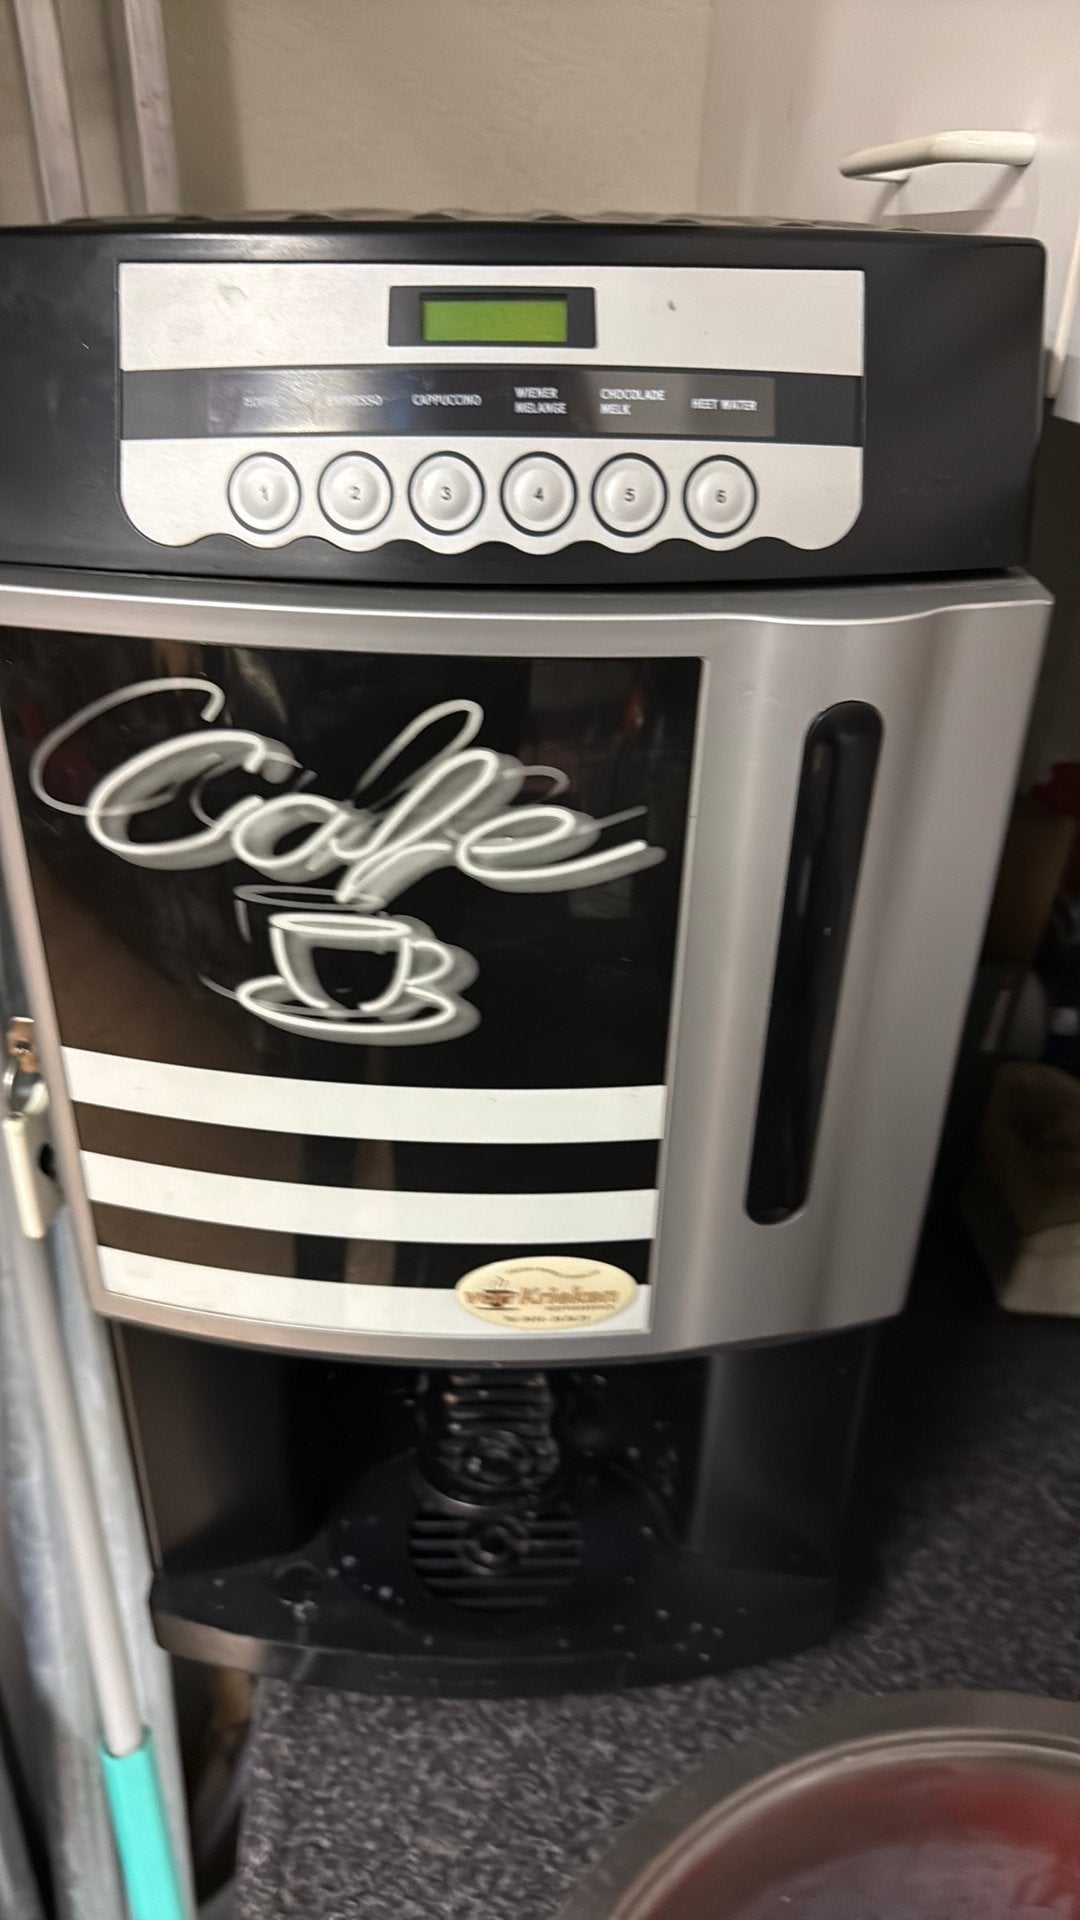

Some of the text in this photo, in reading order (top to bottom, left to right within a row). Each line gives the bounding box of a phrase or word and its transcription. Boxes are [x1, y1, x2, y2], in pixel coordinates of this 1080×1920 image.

[513, 386, 560, 399] WIENER
[599, 388, 667, 401] CHOCOLADE
[411, 393, 483, 406] CAPPUCCINO
[690, 398, 758, 411] HEET WATER
[513, 402, 568, 414] MELANGE
[599, 403, 632, 415] MELK
[349, 485, 362, 501] 2
[439, 485, 453, 501] 3
[533, 486, 545, 502] 4
[623, 487, 637, 502] 5
[714, 489, 728, 504] 6
